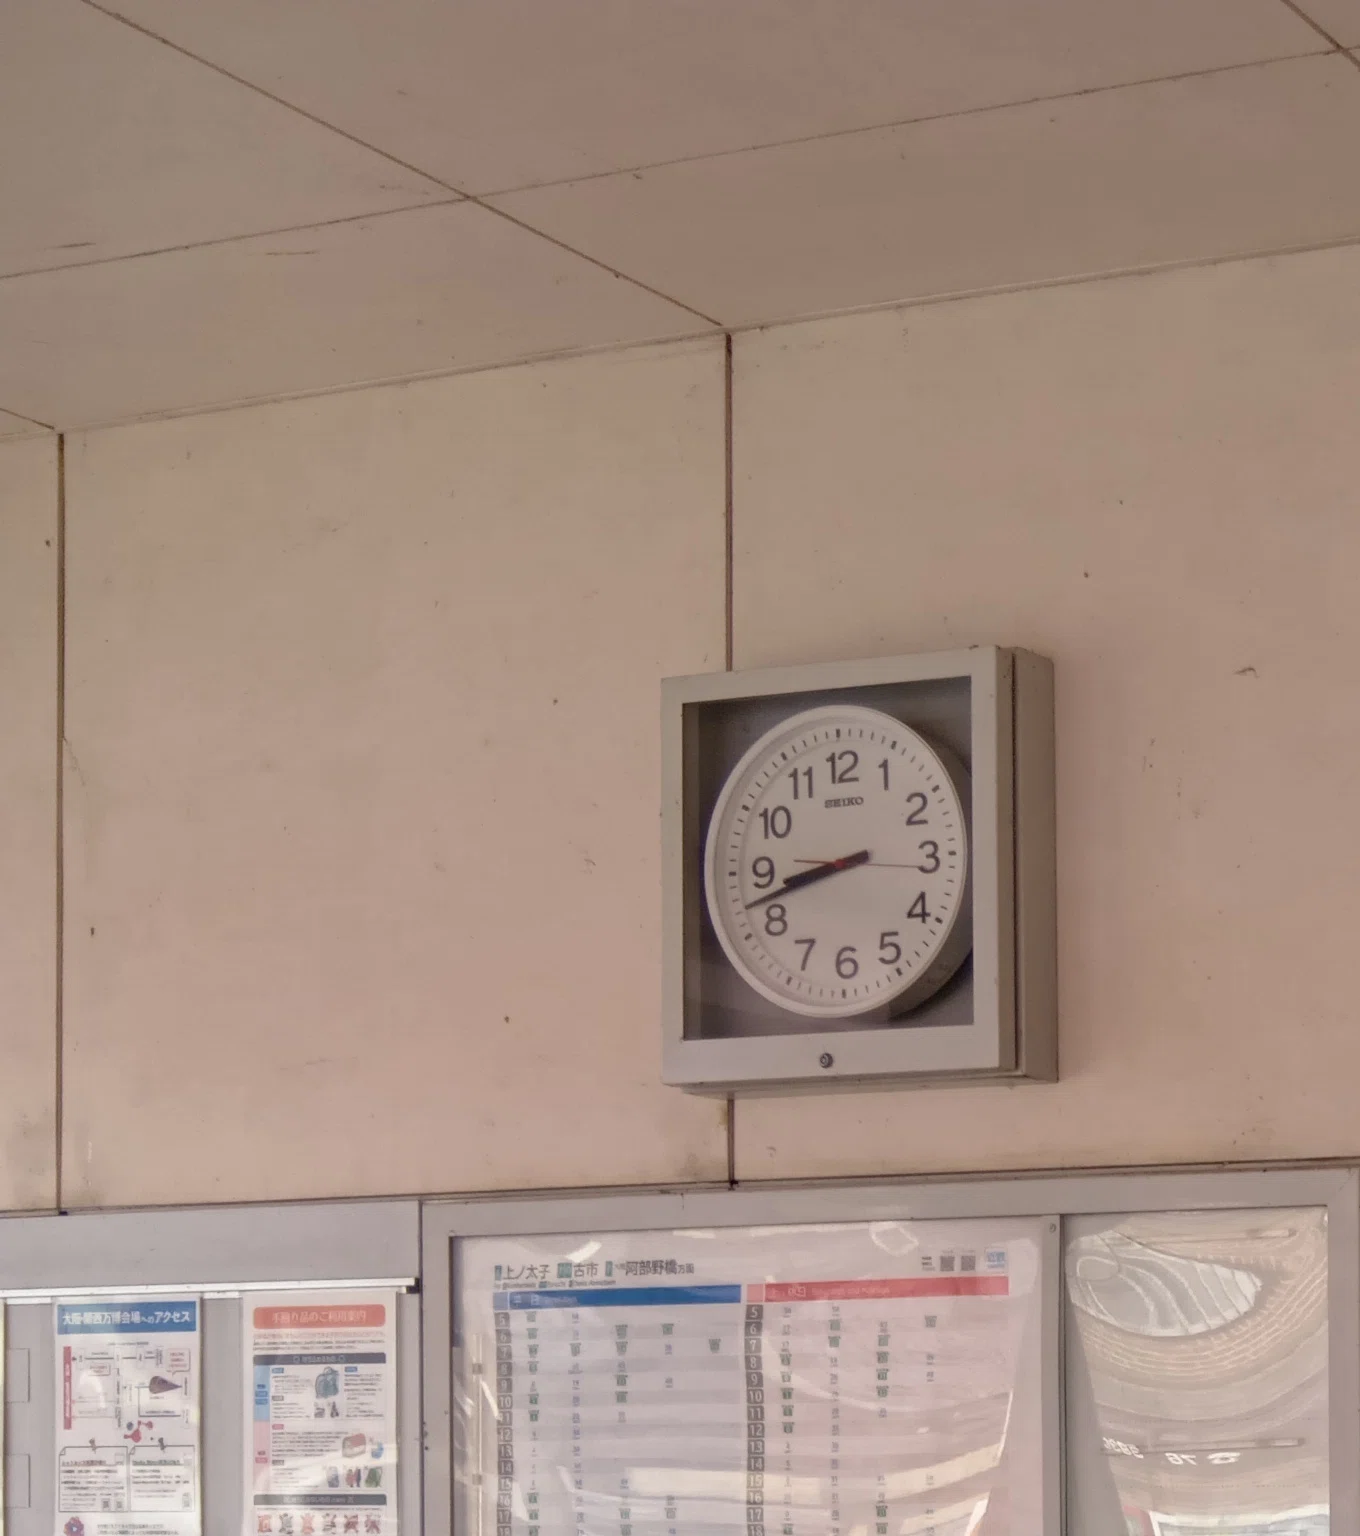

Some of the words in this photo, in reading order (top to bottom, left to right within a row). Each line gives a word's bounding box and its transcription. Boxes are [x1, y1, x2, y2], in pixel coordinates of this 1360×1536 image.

[788, 766, 814, 799] 11
[826, 750, 859, 784] 12
[878, 759, 889, 790] 1
[824, 796, 864, 808] SEIKO
[905, 793, 928, 826] 2
[759, 805, 791, 839] 10
[752, 856, 775, 889] 9
[917, 840, 940, 874] 3
[764, 903, 788, 936] 8
[906, 892, 931, 924] 4
[794, 938, 815, 971] 7
[835, 946, 858, 979] 6
[878, 931, 901, 964] 5
